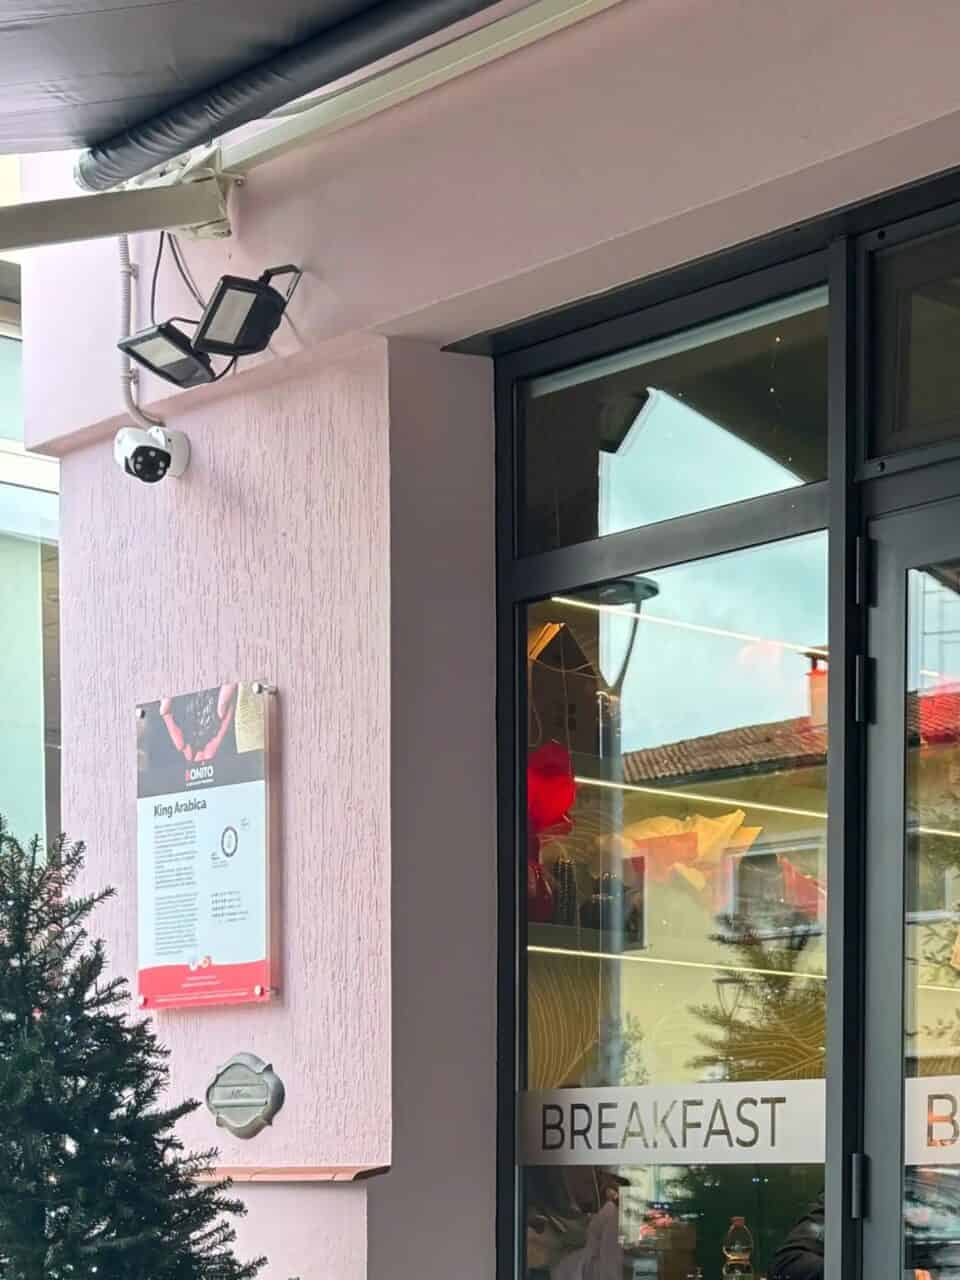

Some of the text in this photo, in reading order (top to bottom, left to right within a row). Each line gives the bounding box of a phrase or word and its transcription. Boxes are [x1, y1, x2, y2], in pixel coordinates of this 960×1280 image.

[154, 797, 207, 818] King Arabica
[542, 1096, 786, 1150] BREAKFAST
